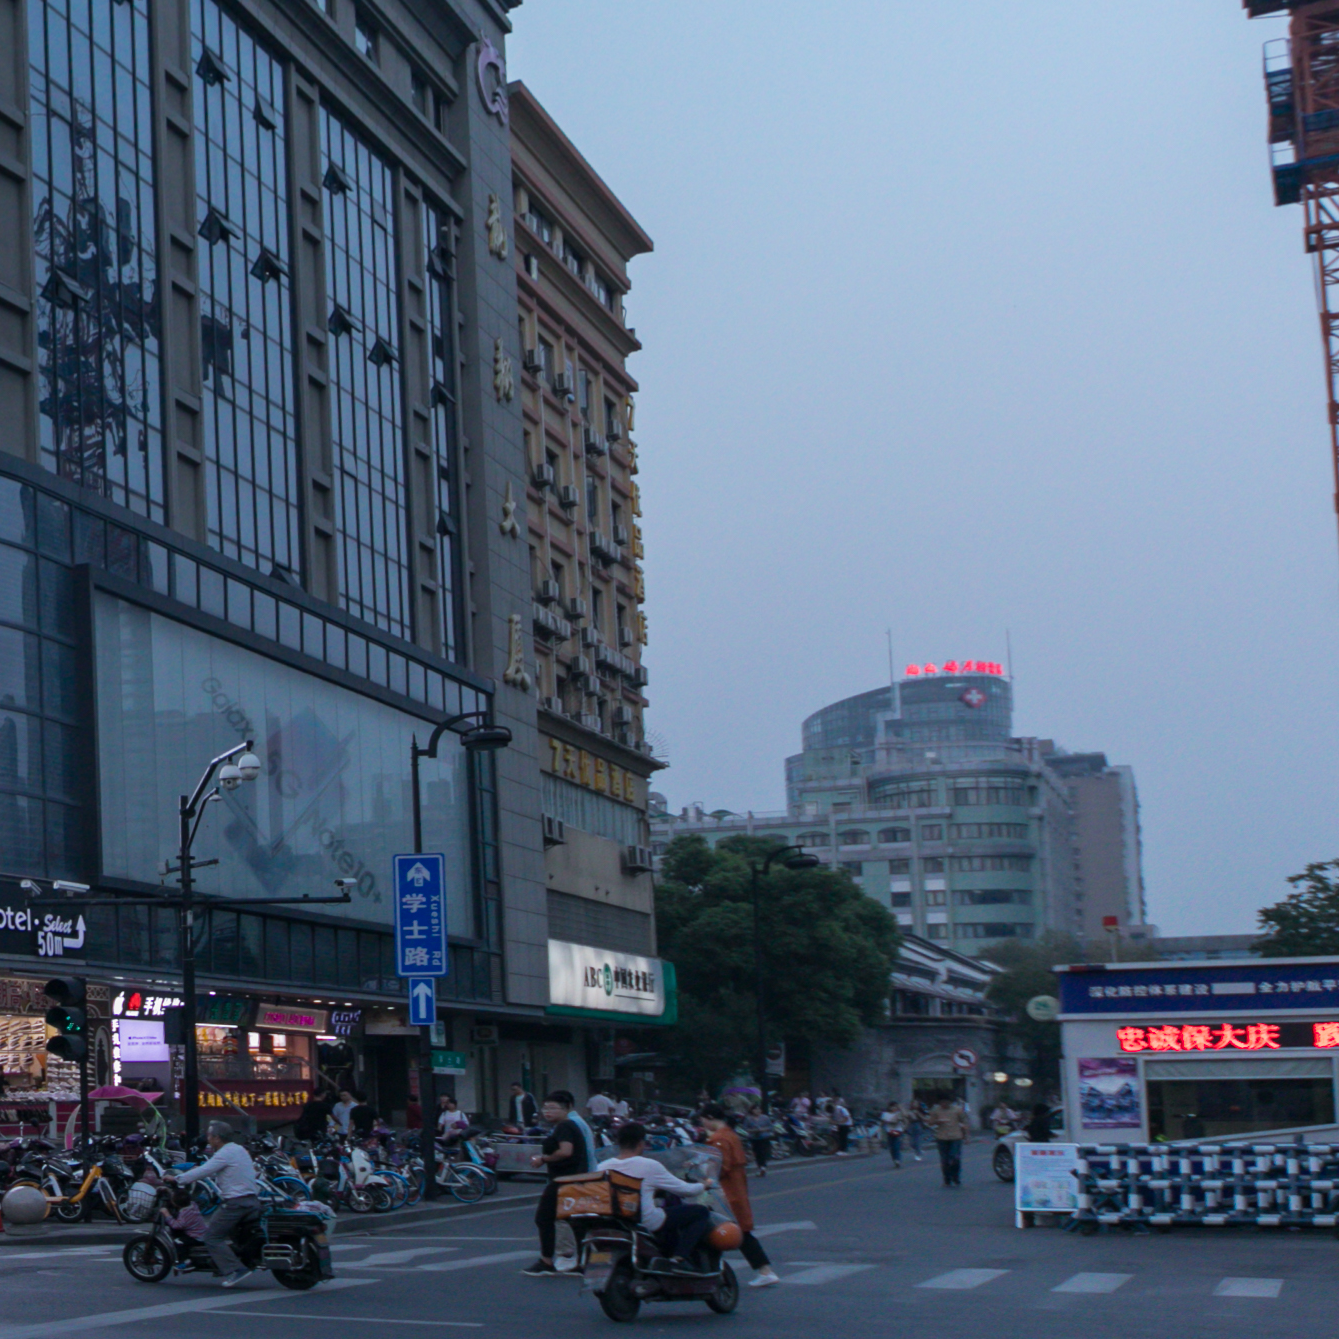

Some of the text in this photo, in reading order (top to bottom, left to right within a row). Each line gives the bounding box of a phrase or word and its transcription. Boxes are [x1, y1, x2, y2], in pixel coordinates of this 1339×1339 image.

[43, 913, 73, 934] Select
[402, 893, 430, 966] 学士路
[430, 895, 442, 966] Xueshi Rd
[37, 930, 63, 957] 50m
[584, 966, 603, 988] ABC
[1117, 1022, 1281, 1052] 忠诚保大庆
